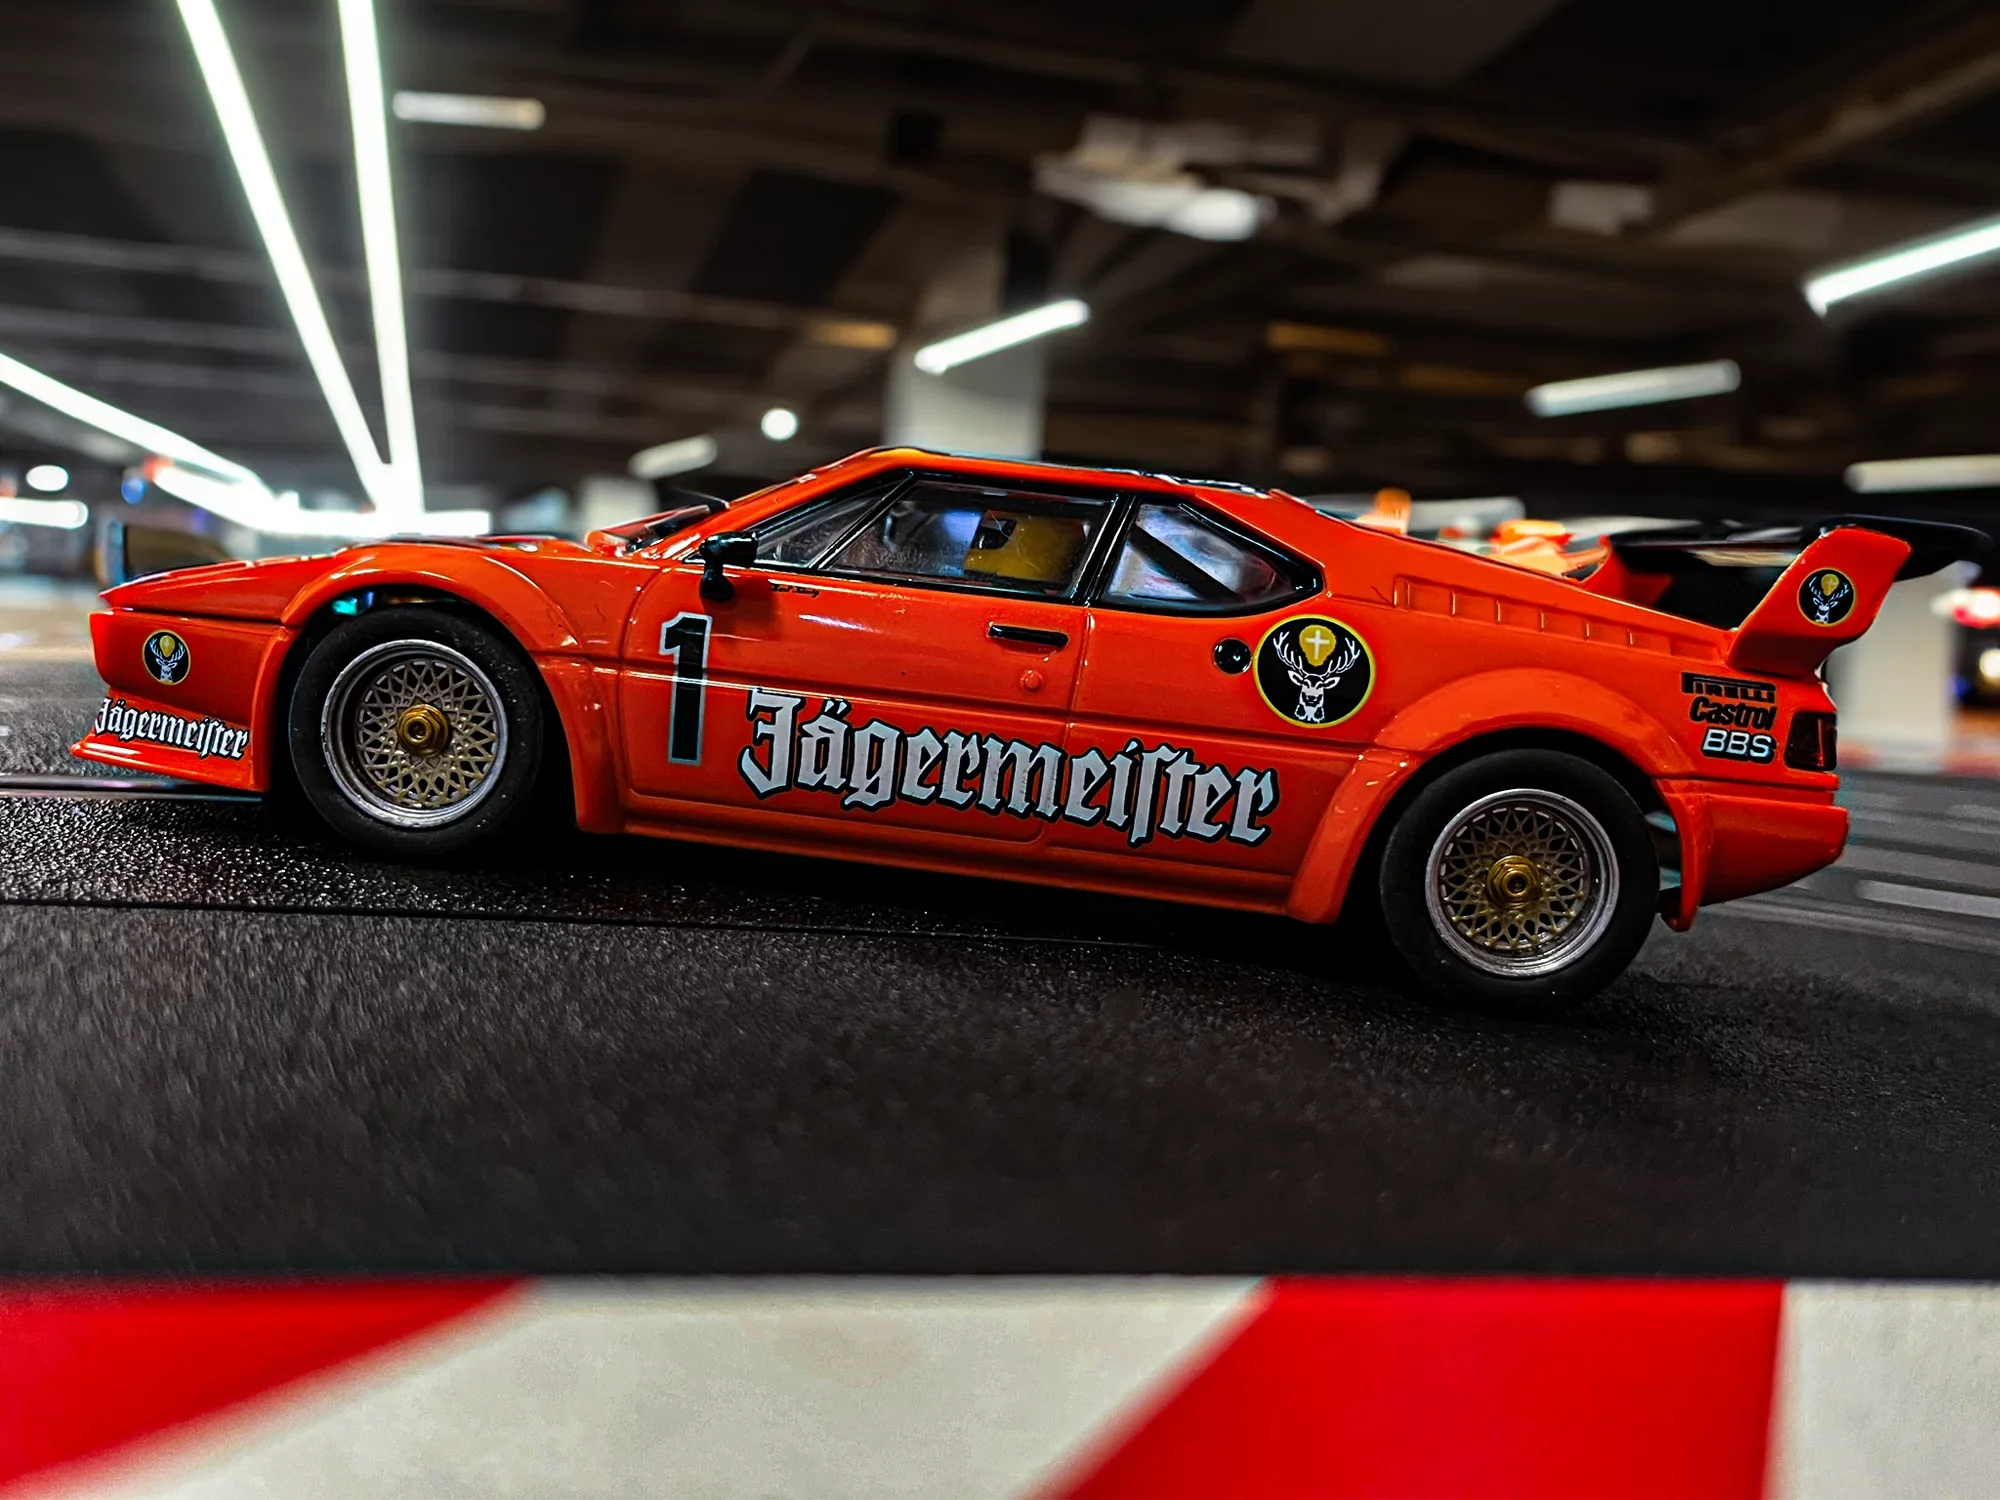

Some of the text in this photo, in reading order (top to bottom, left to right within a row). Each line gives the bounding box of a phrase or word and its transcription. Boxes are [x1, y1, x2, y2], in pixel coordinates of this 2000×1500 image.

[660, 611, 713, 766] 1
[1681, 672, 1777, 703] PIRELLI
[1689, 696, 1777, 731] Castrol
[1702, 727, 1776, 763] BBS
[738, 687, 1279, 846] Jägermeister
